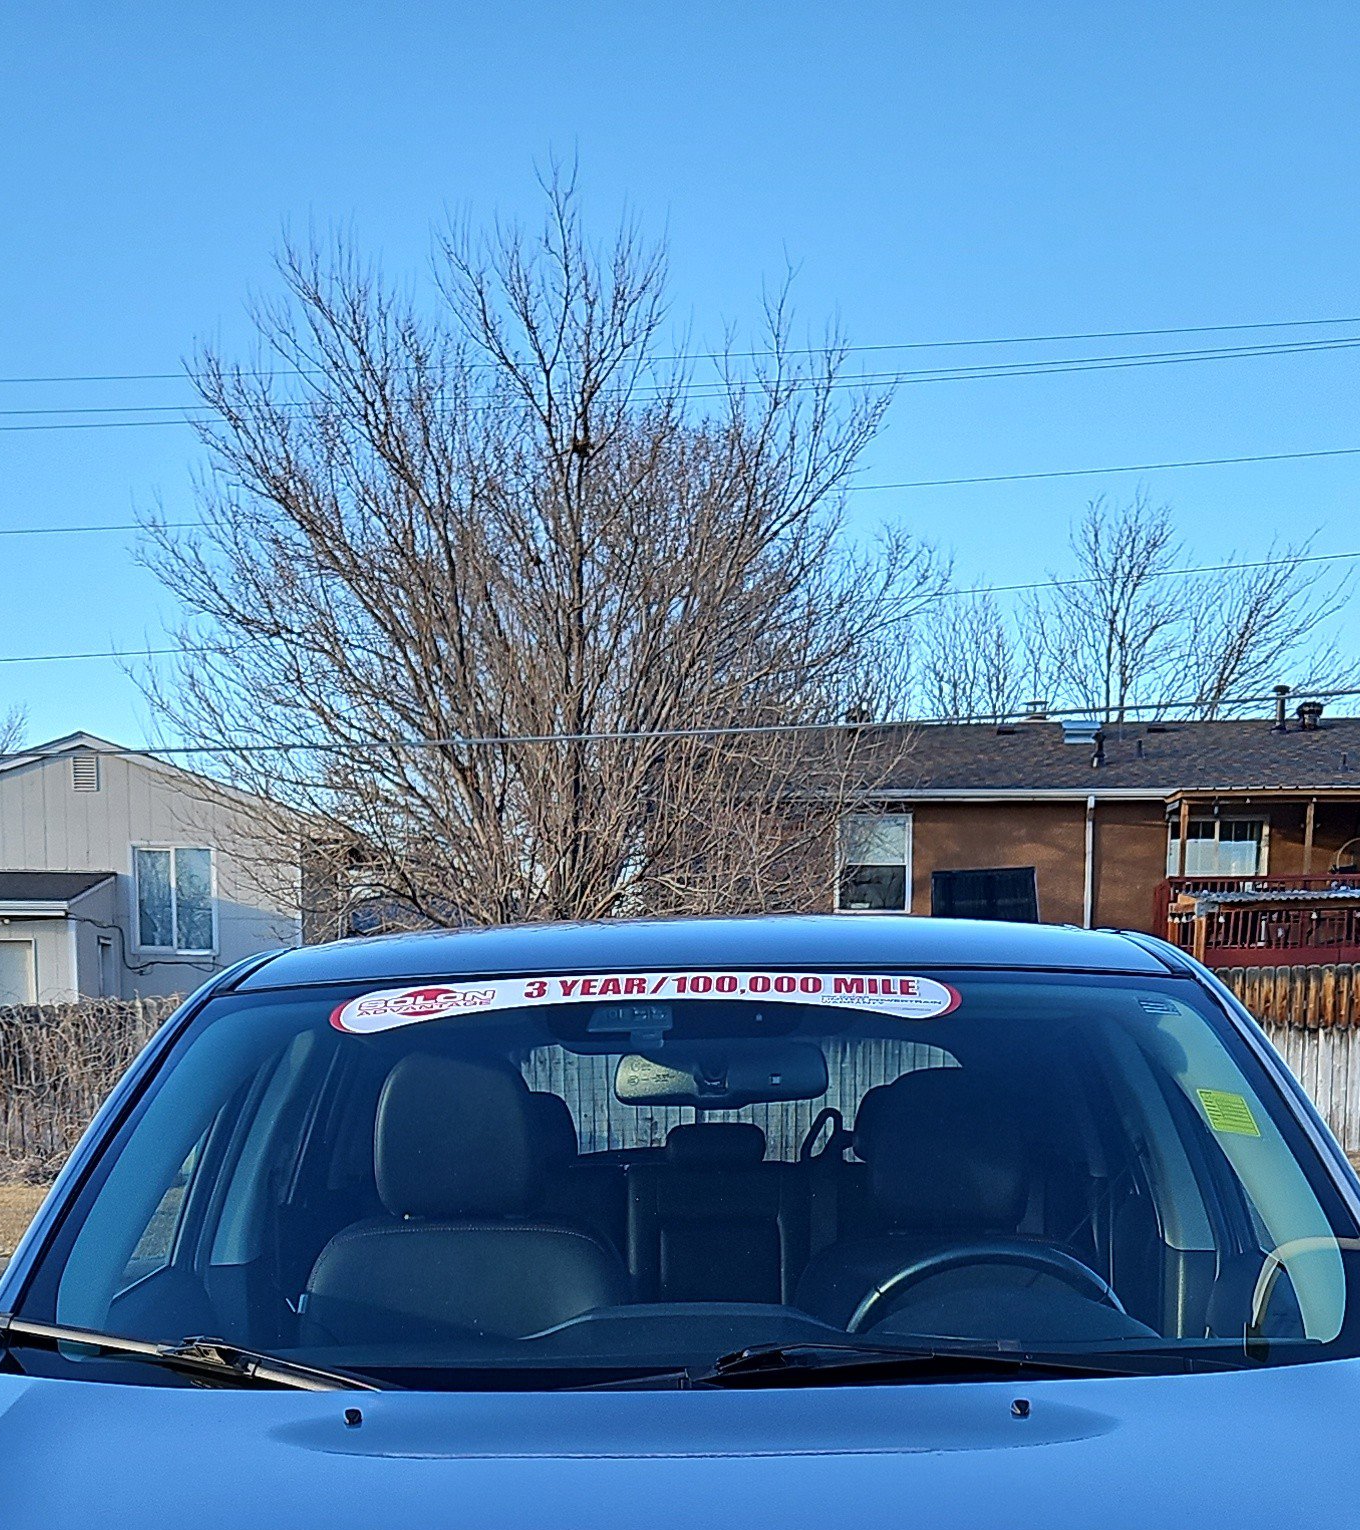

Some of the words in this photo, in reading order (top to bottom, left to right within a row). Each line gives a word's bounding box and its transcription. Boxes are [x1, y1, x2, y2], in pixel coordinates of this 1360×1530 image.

[524, 980, 547, 999] 3
[833, 977, 918, 996] MILE
[356, 999, 492, 1017] ADVANTAGE
[357, 989, 496, 1011] SOLON
